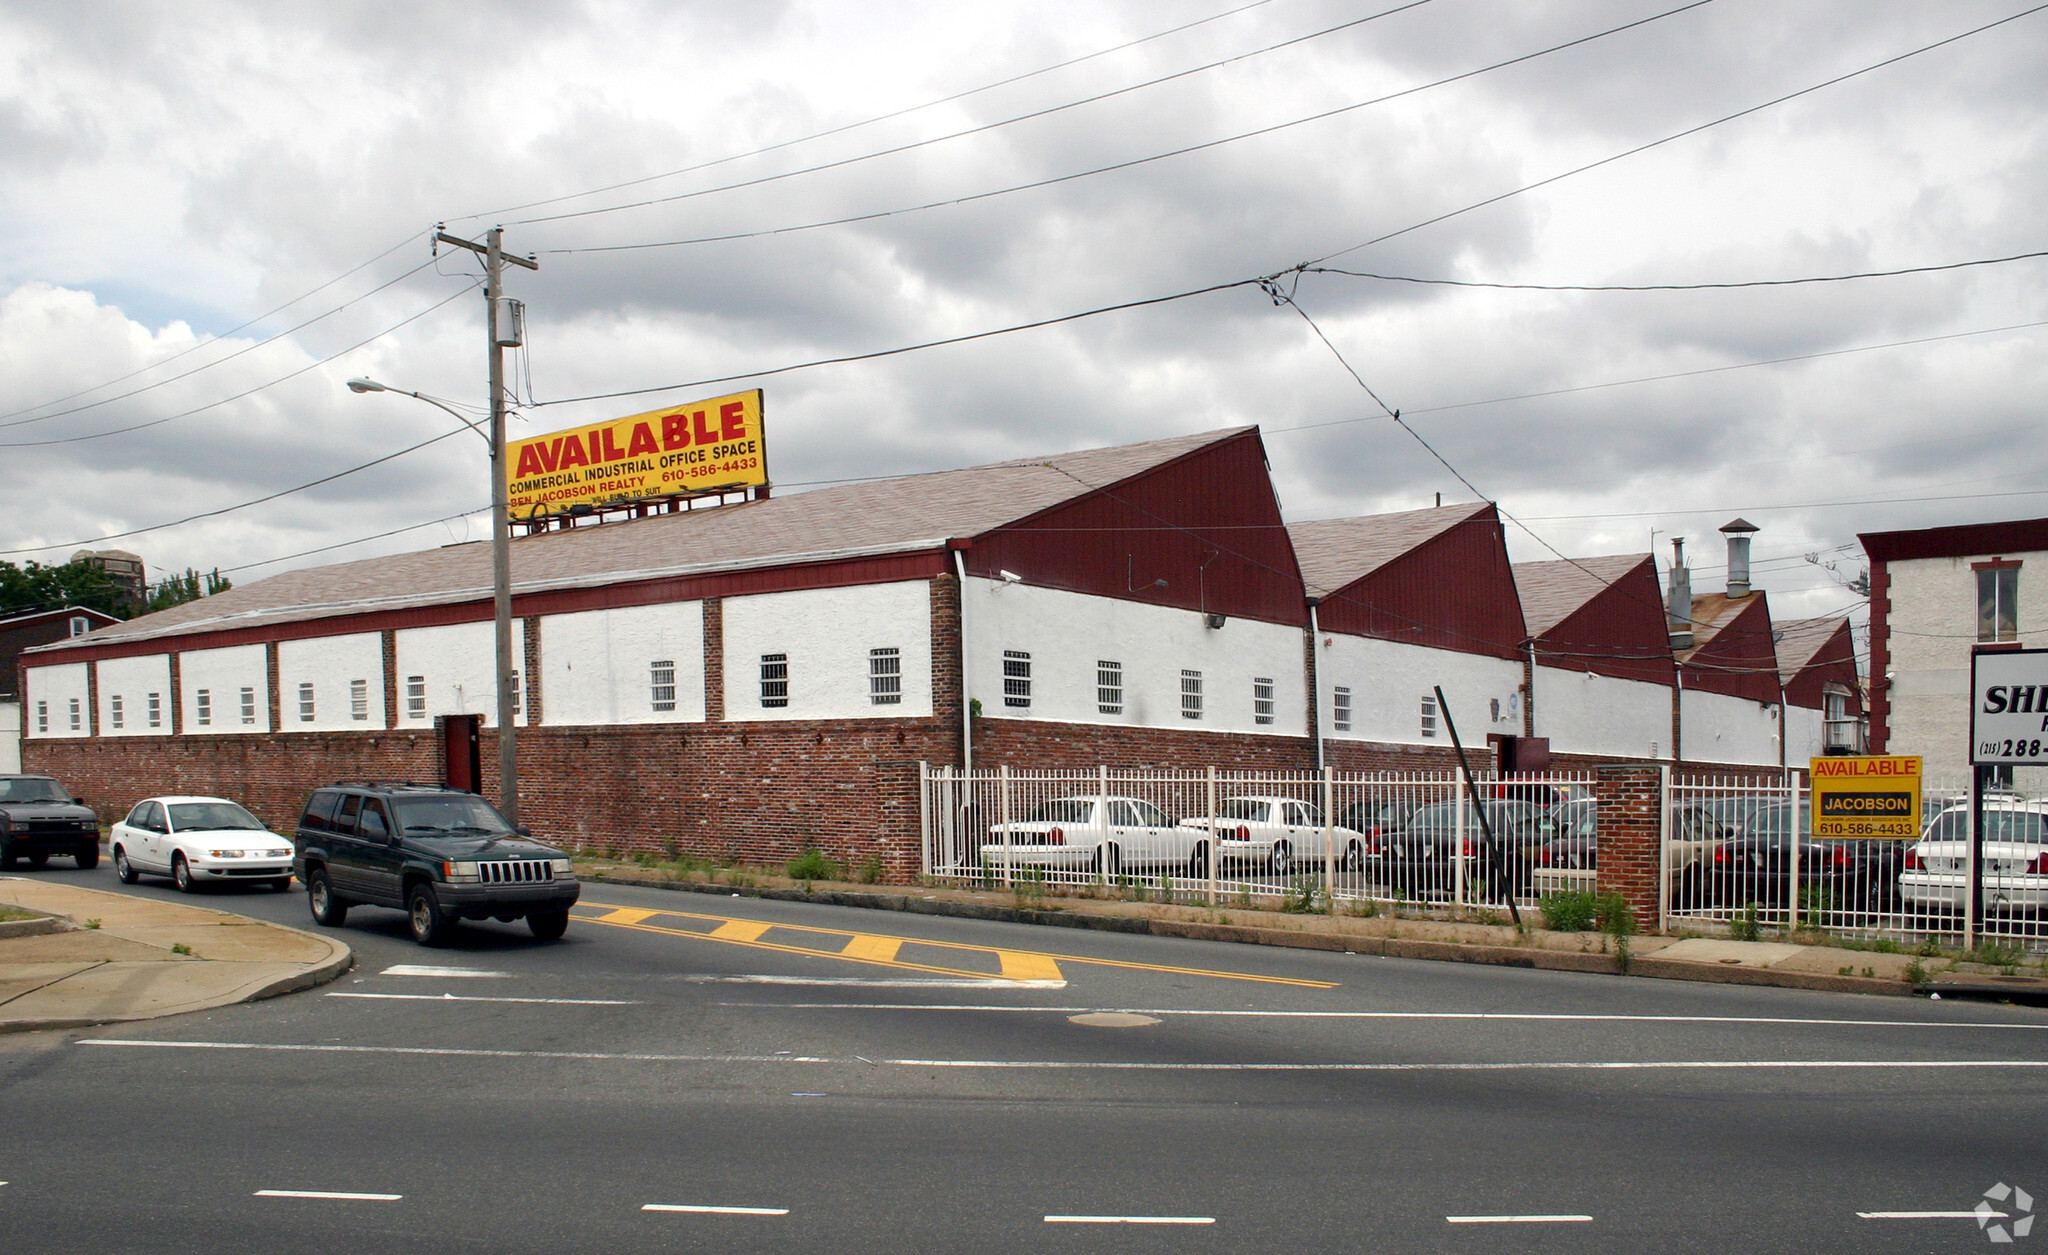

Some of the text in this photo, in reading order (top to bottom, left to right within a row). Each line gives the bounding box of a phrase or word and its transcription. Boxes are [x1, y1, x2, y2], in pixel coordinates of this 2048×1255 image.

[516, 401, 746, 479] AVAILABLE
[509, 440, 757, 495] COMMERCIAL INDUSTRIAL OFFICE SPACE
[510, 457, 758, 508] BEN JACOBSON REALTY 610-586-4433
[609, 491, 630, 502] BUD
[632, 489, 642, 498] TO
[645, 486, 661, 496] SUIT
[1814, 760, 1917, 776] AVAILABLE
[1825, 798, 1908, 810] JACOBSON
[1820, 823, 1913, 835] 610-586-4433
